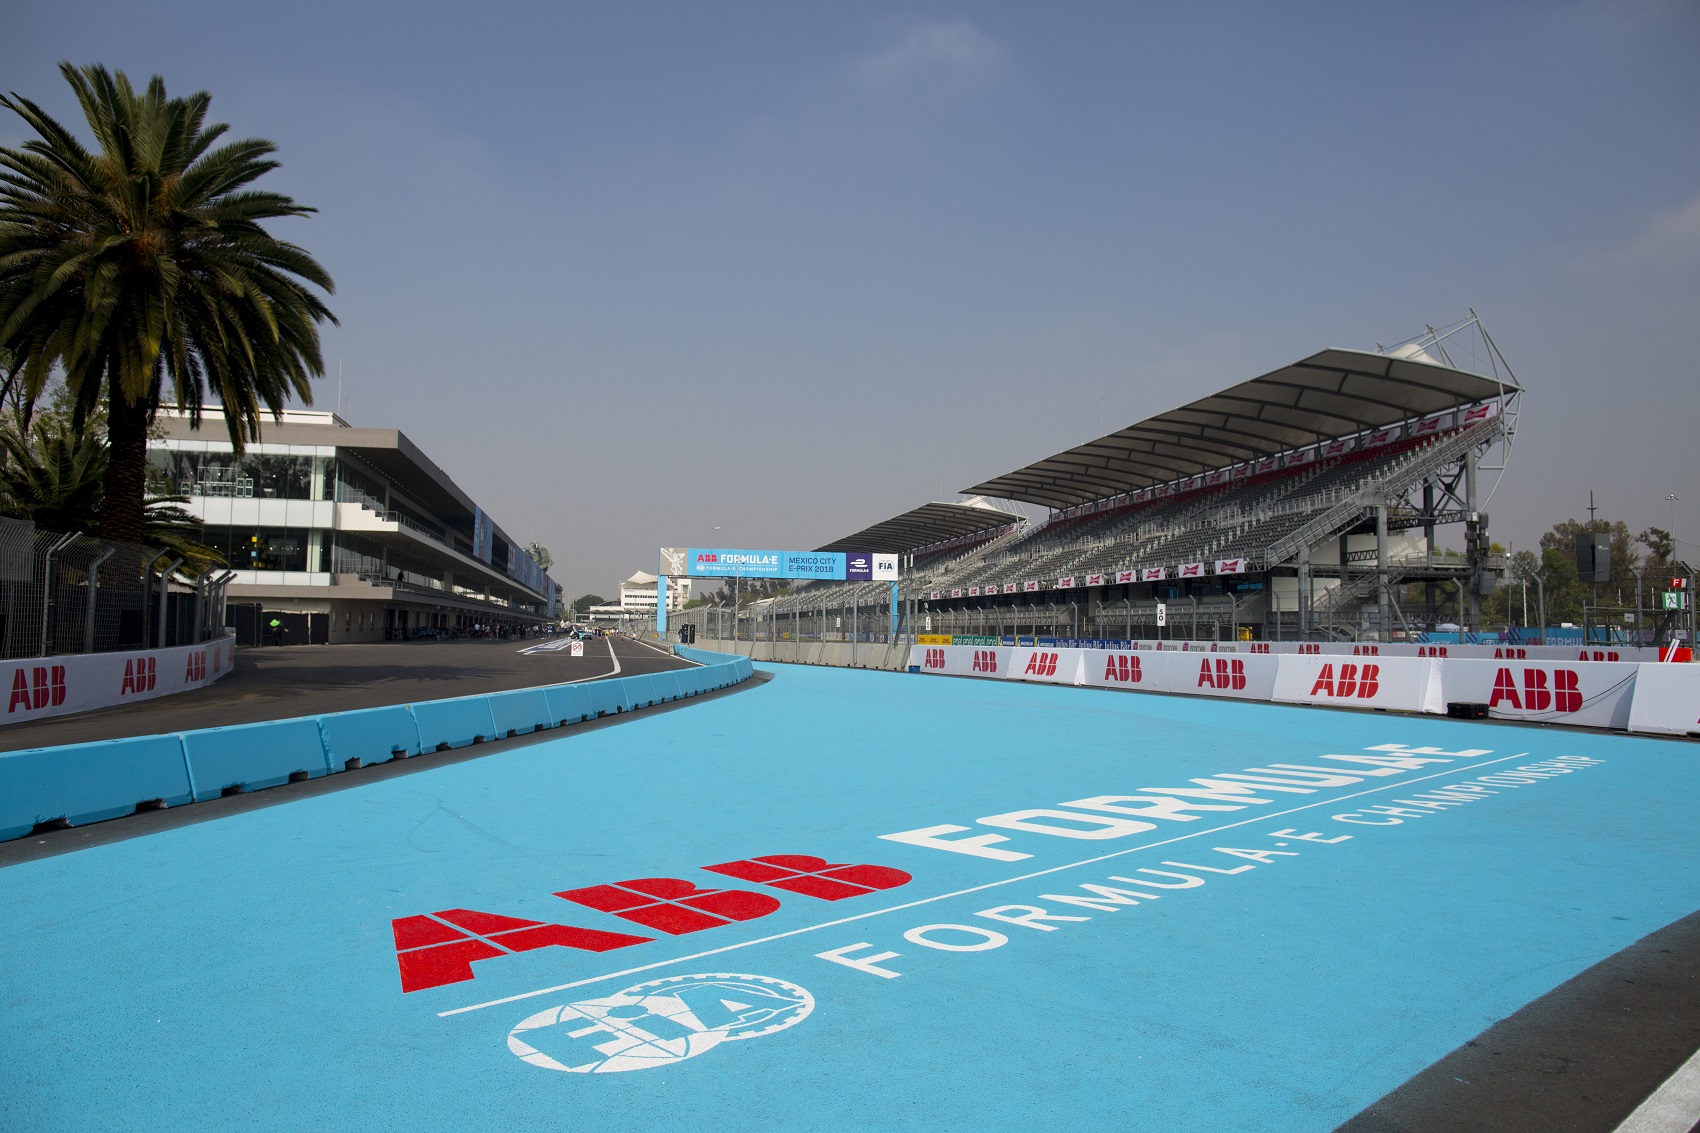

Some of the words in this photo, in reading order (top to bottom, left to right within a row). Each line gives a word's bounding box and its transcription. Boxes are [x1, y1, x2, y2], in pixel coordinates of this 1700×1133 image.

[697, 554, 718, 563] ABB
[788, 557, 819, 565] MEXICO
[814, 565, 834, 573] 2018
[1673, 578, 1680, 586] F
[185, 651, 206, 683] ABB
[925, 649, 945, 669] ABB
[973, 650, 997, 673] ABB
[1025, 652, 1058, 676] ABB
[1104, 655, 1142, 683] ABB
[1198, 658, 1247, 690] ABB
[8, 665, 67, 713] ABB
[121, 657, 156, 695] ABB
[1310, 664, 1379, 698] ABB
[1489, 667, 1583, 713] ABB
[1331, 755, 1605, 826] CHAMPIONSHIP
[392, 854, 912, 993] ABB
